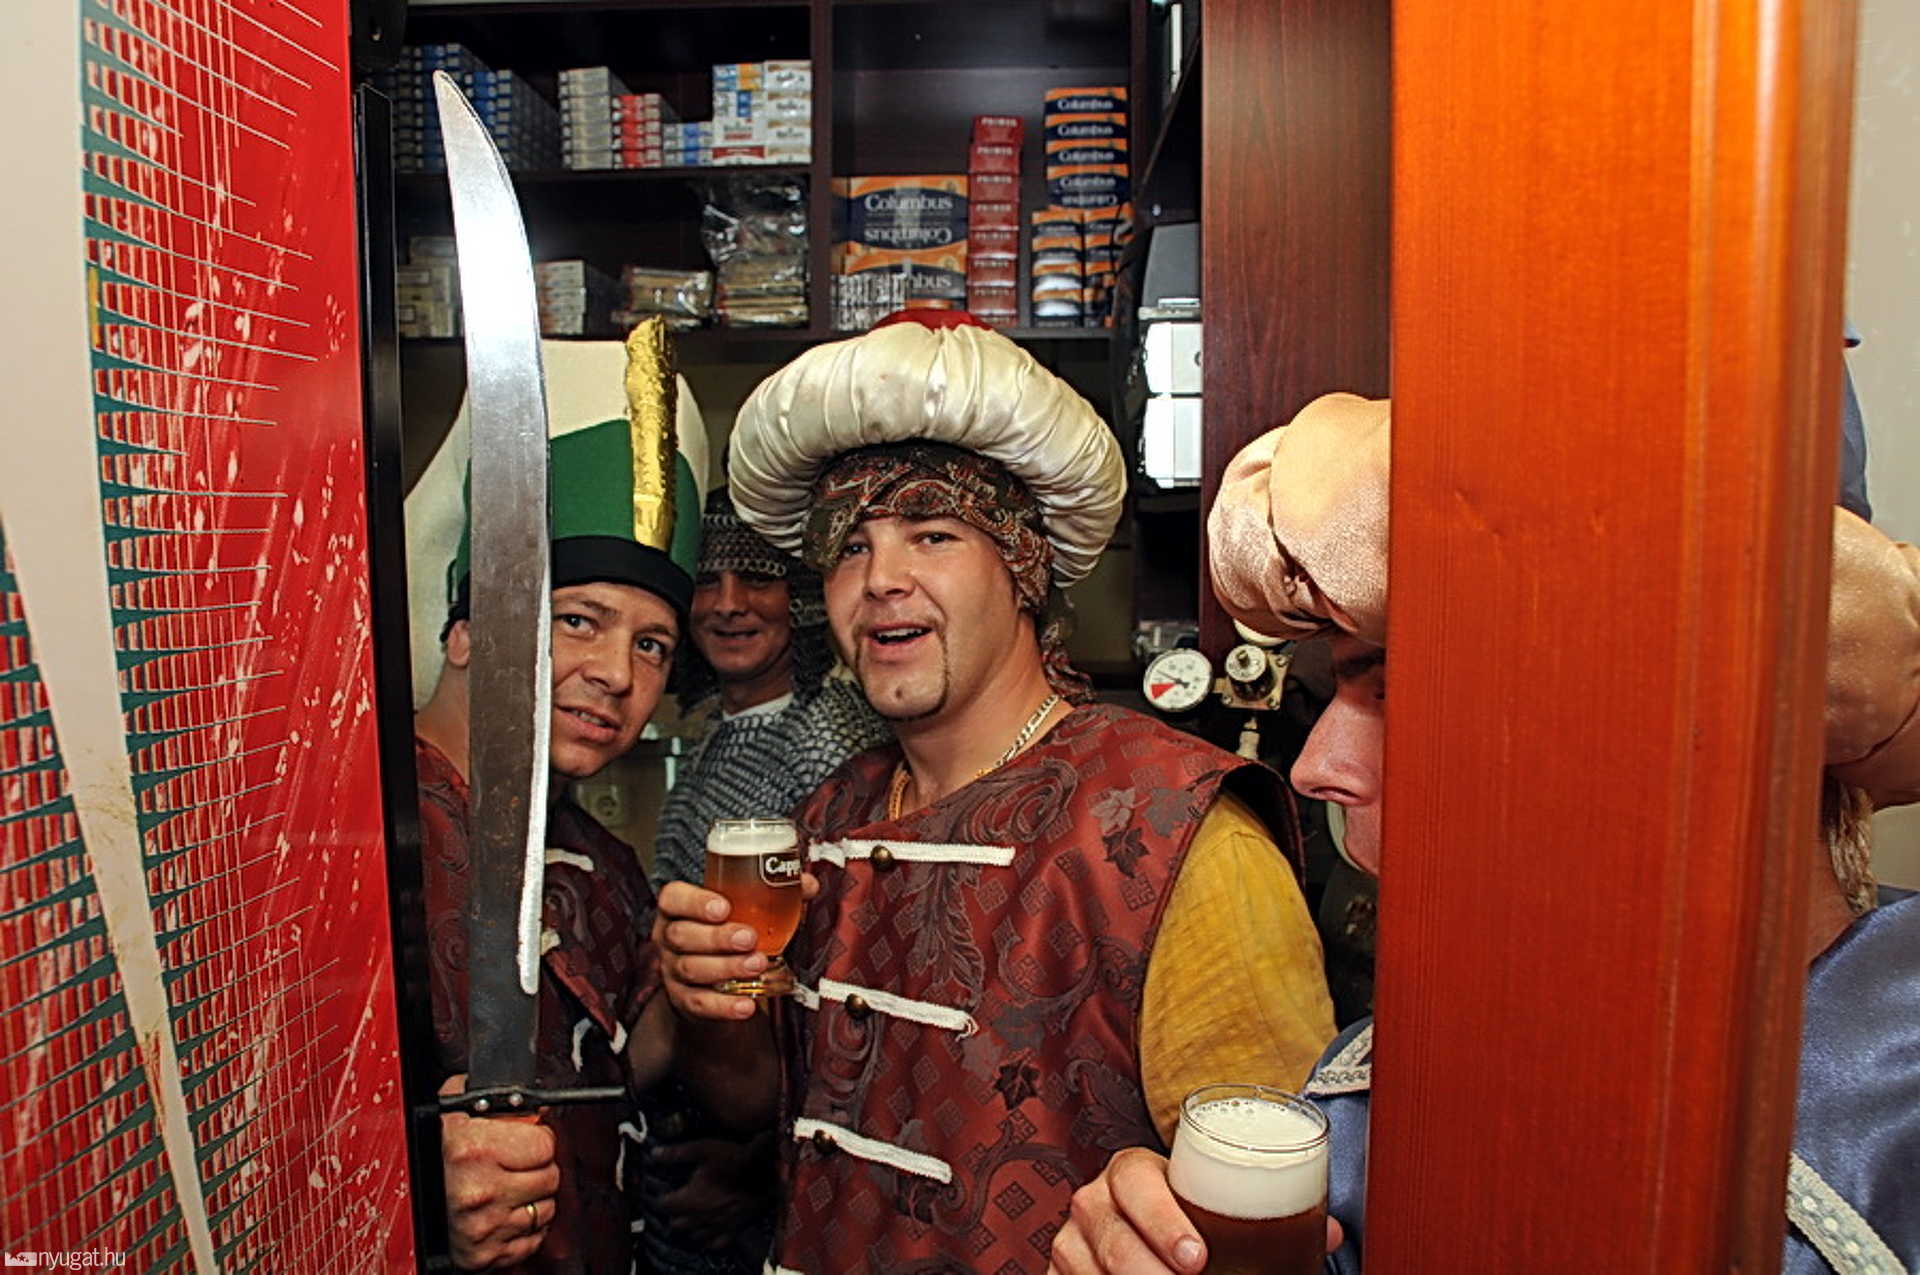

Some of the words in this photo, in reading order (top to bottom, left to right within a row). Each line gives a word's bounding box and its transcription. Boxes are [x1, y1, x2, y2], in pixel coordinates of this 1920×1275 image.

[864, 193, 953, 212] Columbus
[864, 227, 953, 244] Columbus
[765, 856, 800, 877] Capp
